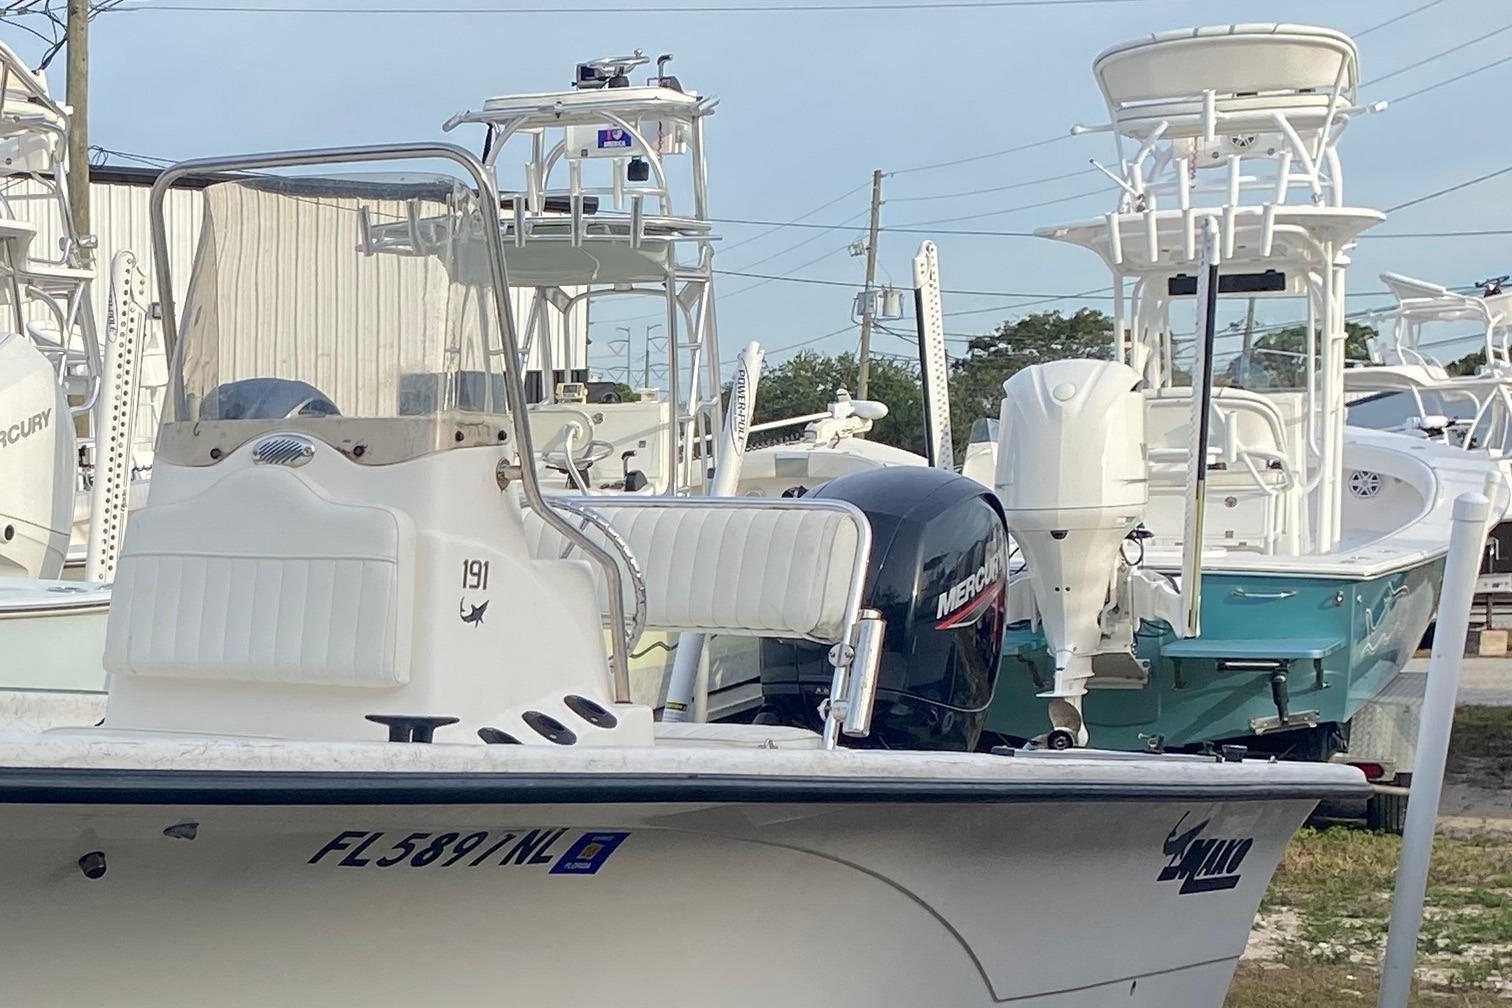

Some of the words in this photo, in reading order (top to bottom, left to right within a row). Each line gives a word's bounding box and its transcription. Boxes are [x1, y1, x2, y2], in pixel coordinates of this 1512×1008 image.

[737, 369, 747, 442] POWER-POLE
[462, 559, 489, 590] 191
[1157, 837, 1253, 895] MAKO
